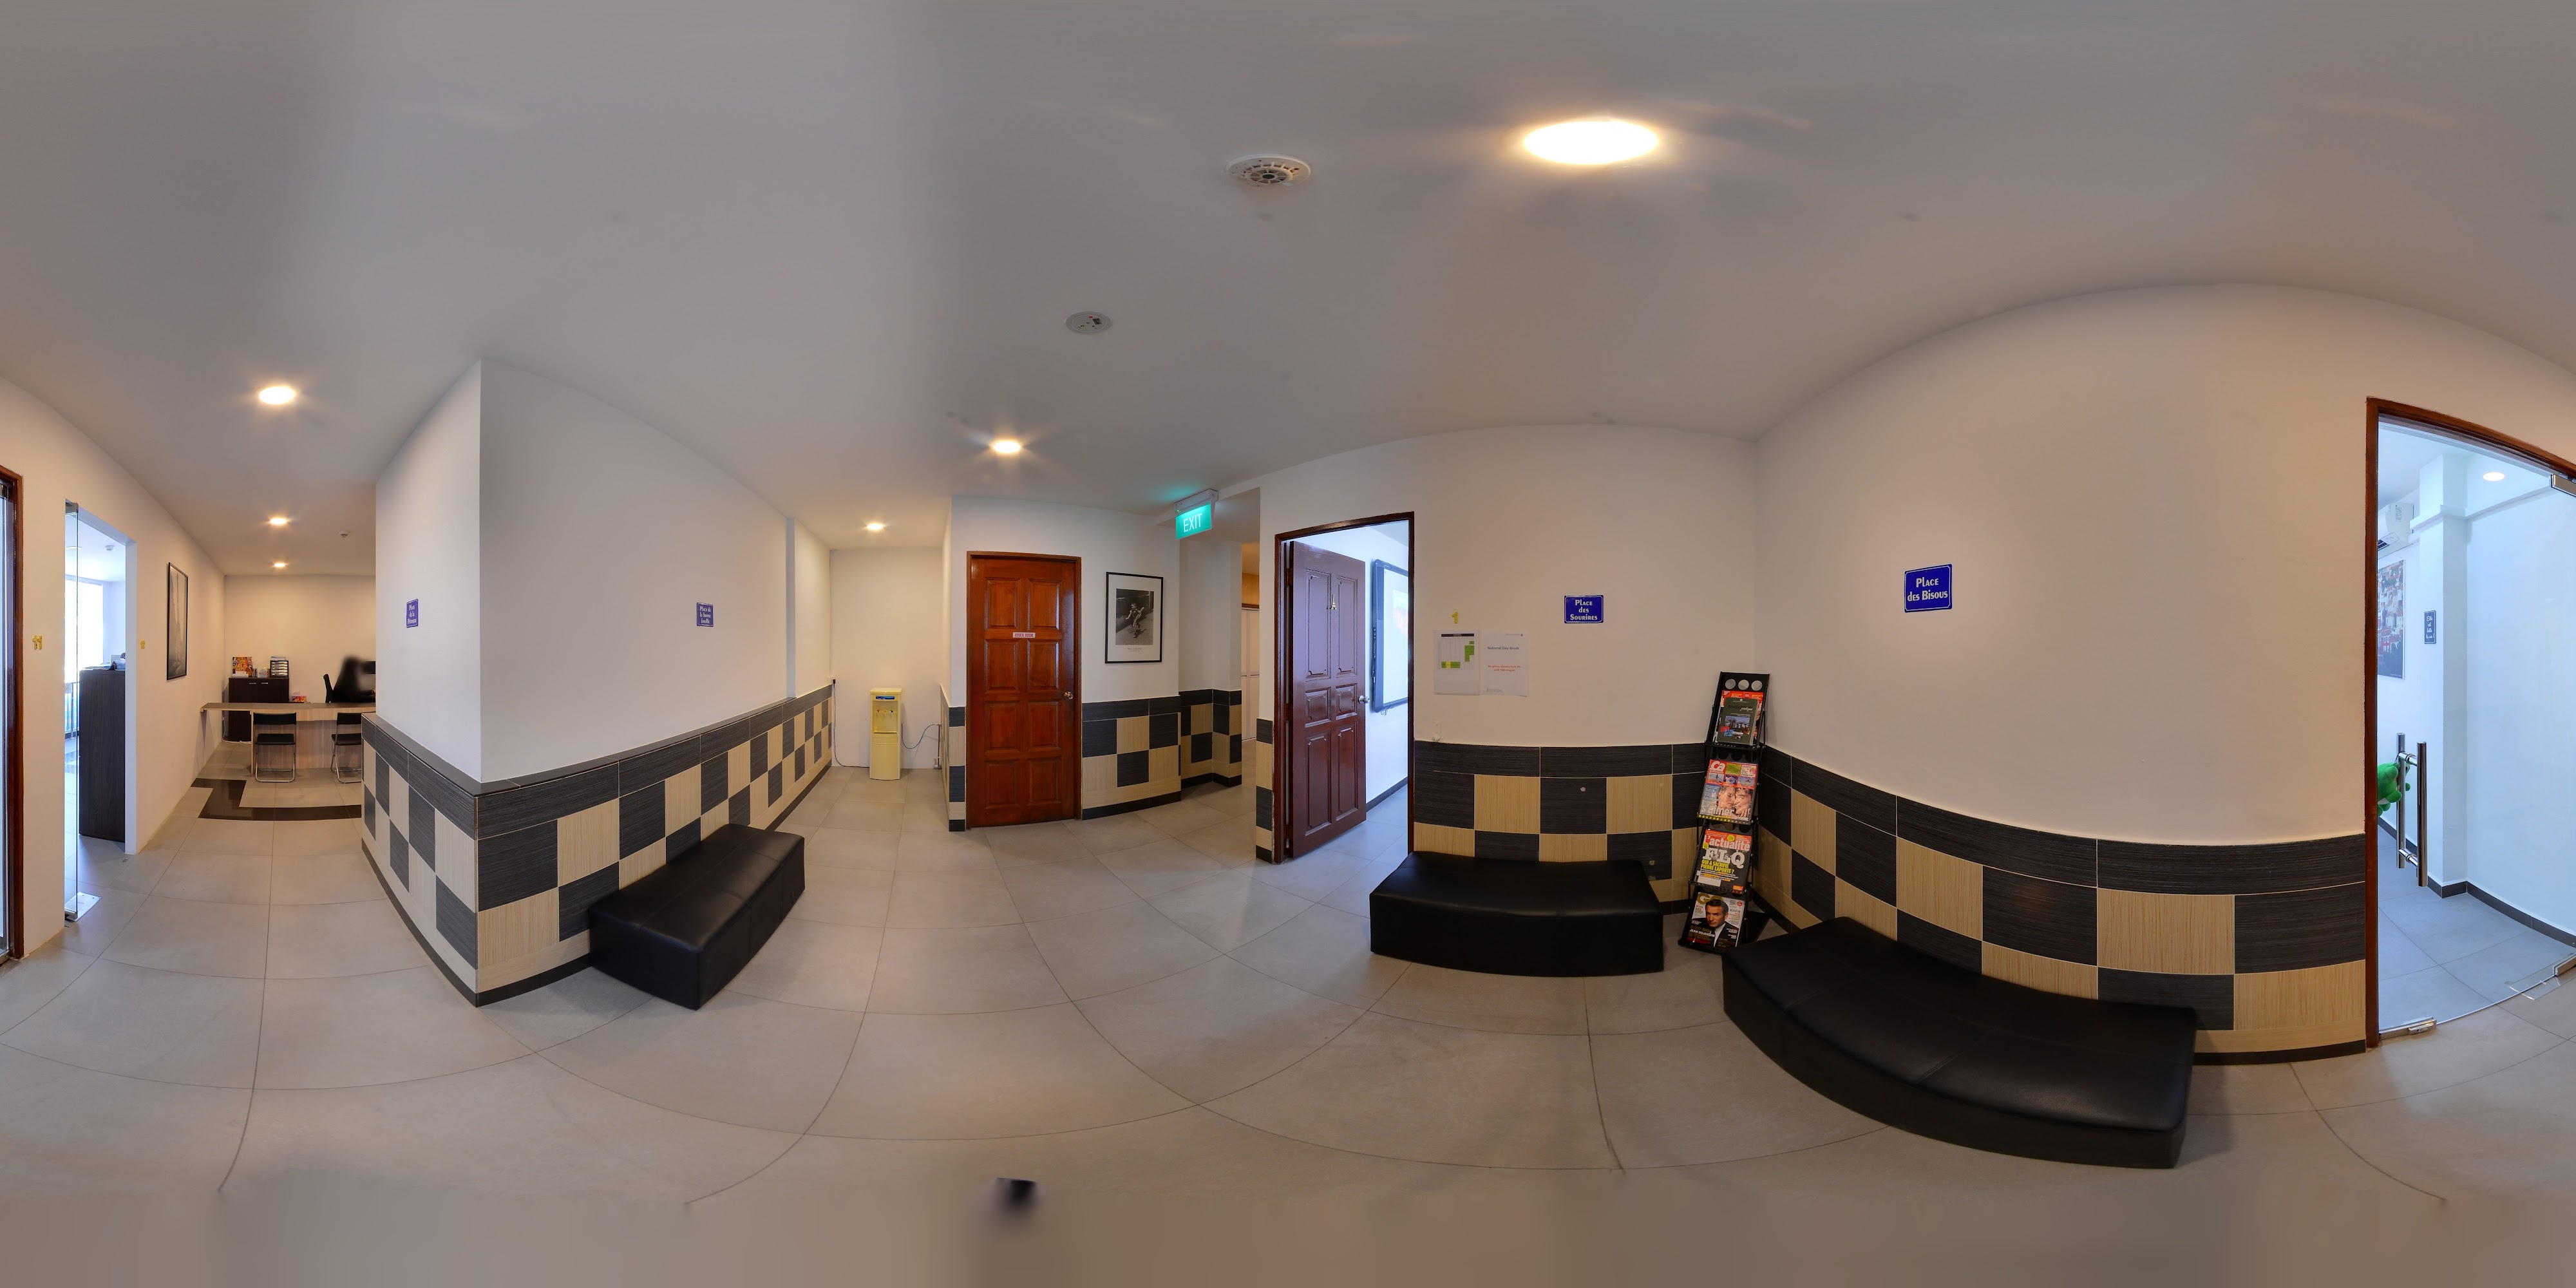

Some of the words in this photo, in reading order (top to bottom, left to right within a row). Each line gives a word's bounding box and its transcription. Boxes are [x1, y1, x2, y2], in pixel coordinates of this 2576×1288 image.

[1183, 513, 1202, 533] EXIT
[1452, 611, 1458, 623] 1
[32, 635, 43, 650] 11
[1702, 848, 1745, 869] FLQ
[1714, 866, 1732, 874] LAPORTE
